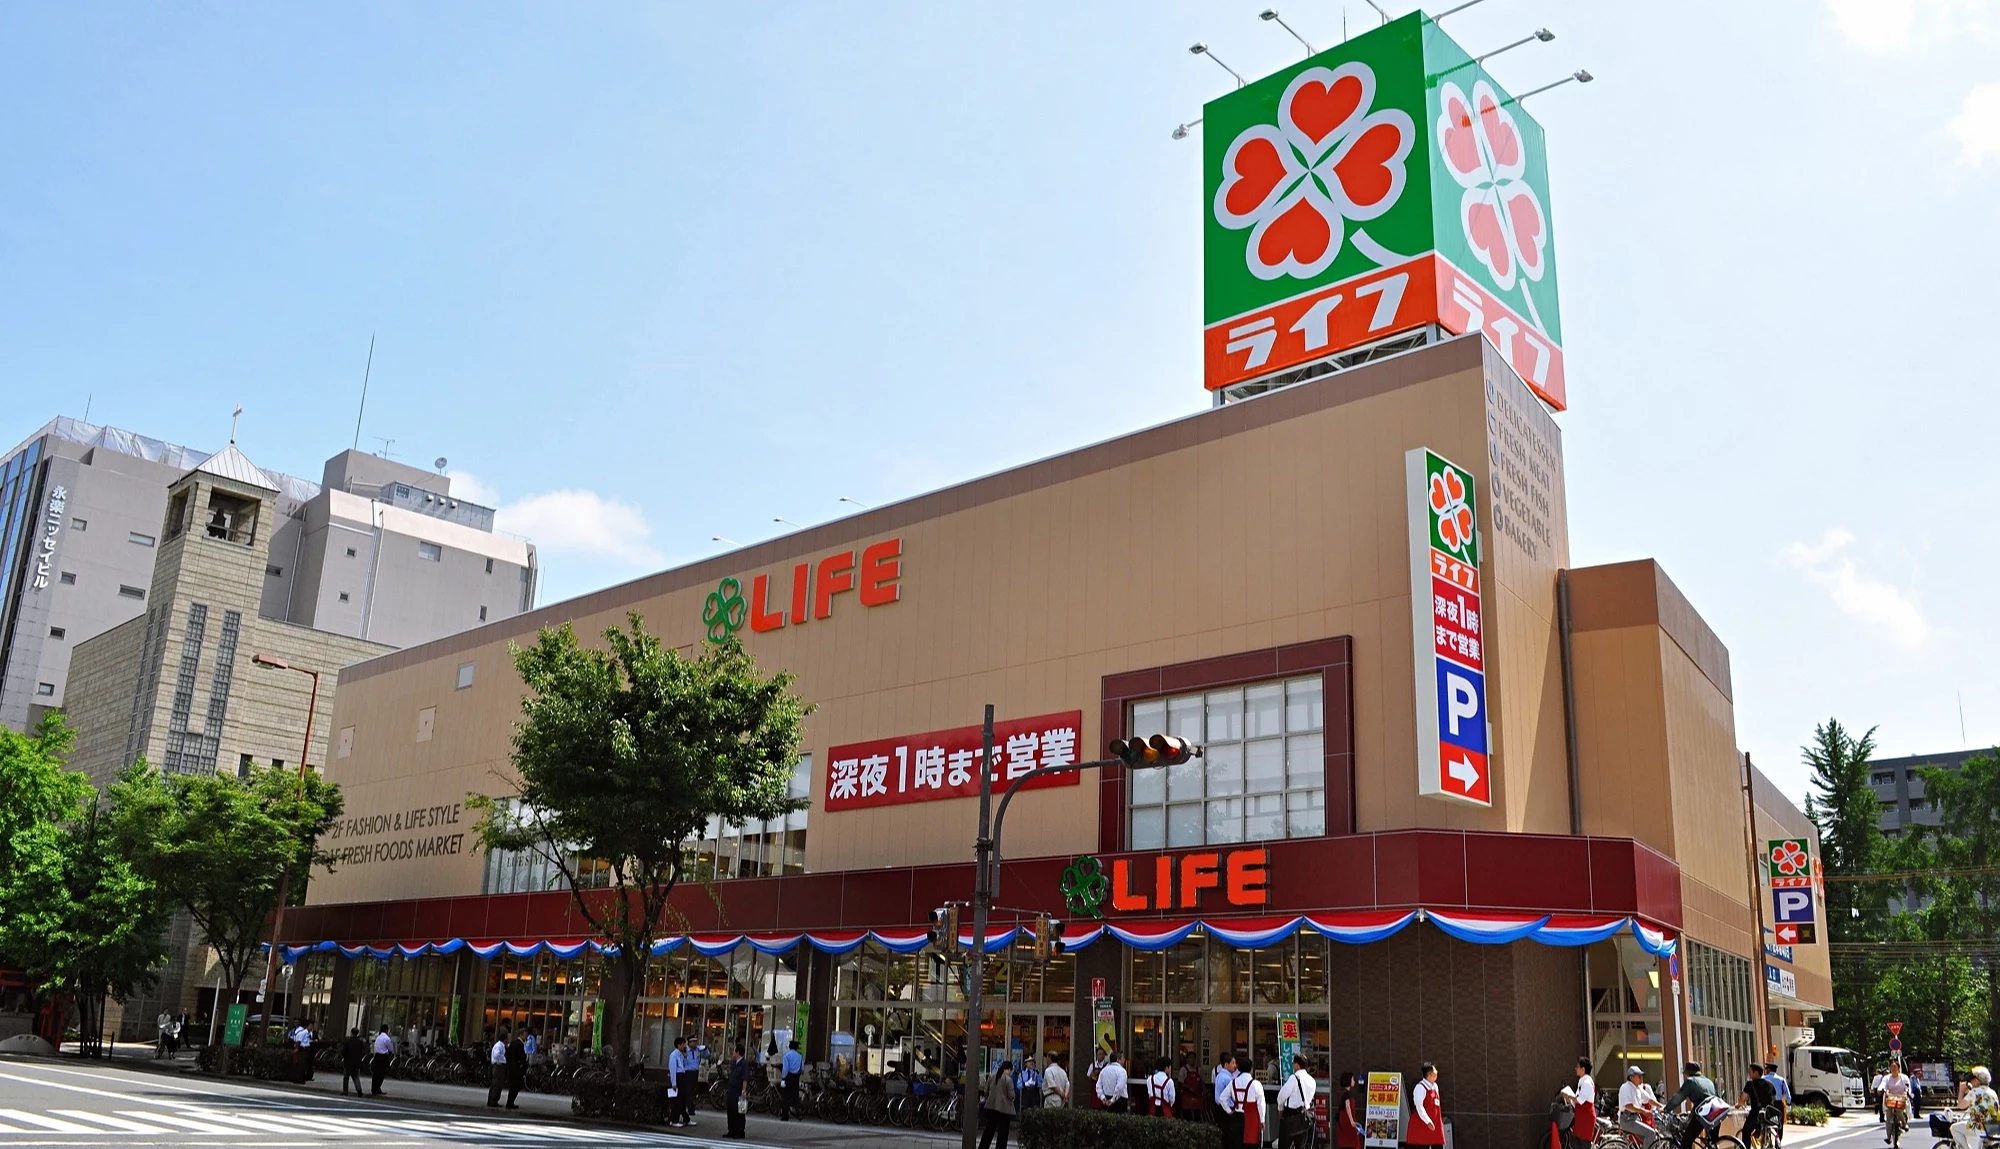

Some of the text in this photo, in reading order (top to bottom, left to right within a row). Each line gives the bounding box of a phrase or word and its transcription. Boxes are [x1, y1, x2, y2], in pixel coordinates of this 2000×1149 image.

[1226, 271, 1410, 371] ライフ
[1452, 276, 1551, 388] ライフ
[1496, 389, 1556, 473] DELICATESSEN
[1498, 421, 1551, 493] FRESH MEAT
[1500, 452, 1550, 518] FRESH FISH
[1502, 483, 1551, 548] VEGETABLE
[33, 485, 67, 589] 永楽ニッセイビル
[1504, 514, 1537, 561] BAKERY
[751, 538, 902, 632] LIFE
[1434, 553, 1475, 589] ライフ
[1434, 593, 1479, 635] 深夜1時
[1435, 624, 1480, 661] まで営業
[1446, 671, 1479, 736] P
[829, 727, 1076, 800] 深夜1時まで営業
[331, 803, 460, 839] 2F FASHION & LIFE STYLE
[341, 844, 373, 865] FRESH
[374, 838, 414, 862] FOODS
[415, 833, 464, 858] MARKET
[1113, 849, 1268, 911] LIFE
[1775, 877, 1808, 887] ライフ
[1778, 891, 1809, 920] P
